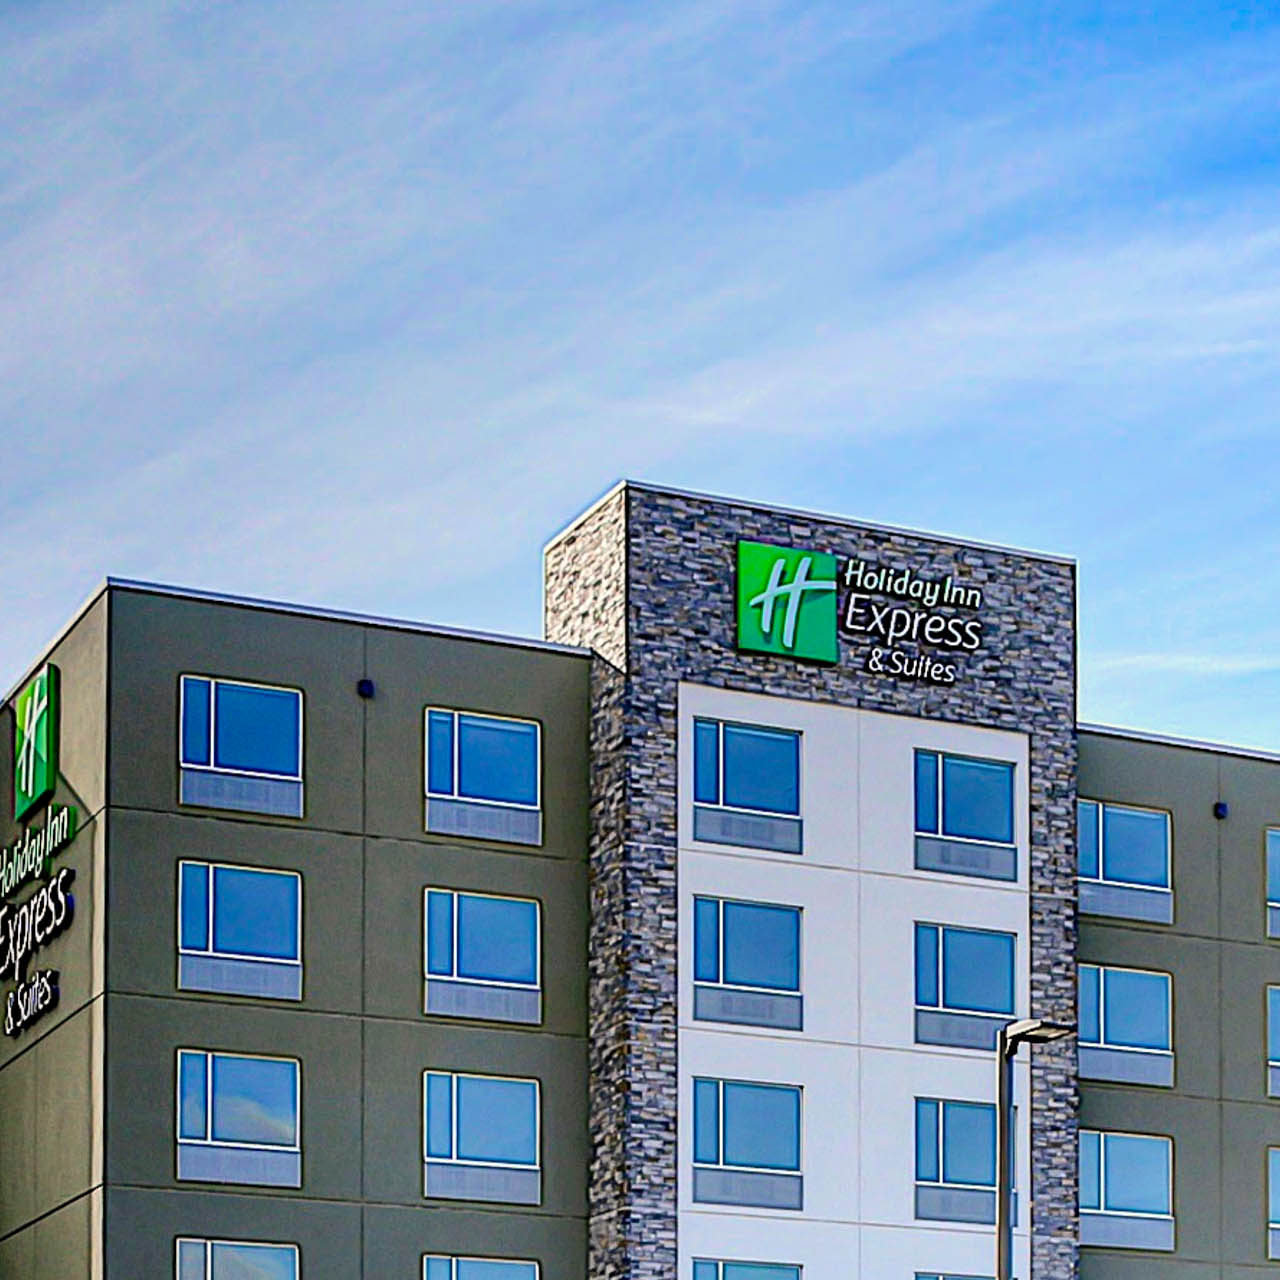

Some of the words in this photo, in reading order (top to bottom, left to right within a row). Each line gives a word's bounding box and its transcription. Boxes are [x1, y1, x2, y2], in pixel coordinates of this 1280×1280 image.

[844, 558, 941, 607] Holiday
[943, 575, 981, 608] Inn
[846, 592, 982, 649] Express
[868, 647, 884, 672] &
[889, 651, 956, 682] Suites
[46, 804, 68, 856] Inn
[5, 992, 15, 1035] &
[16, 970, 52, 1027] Suites
